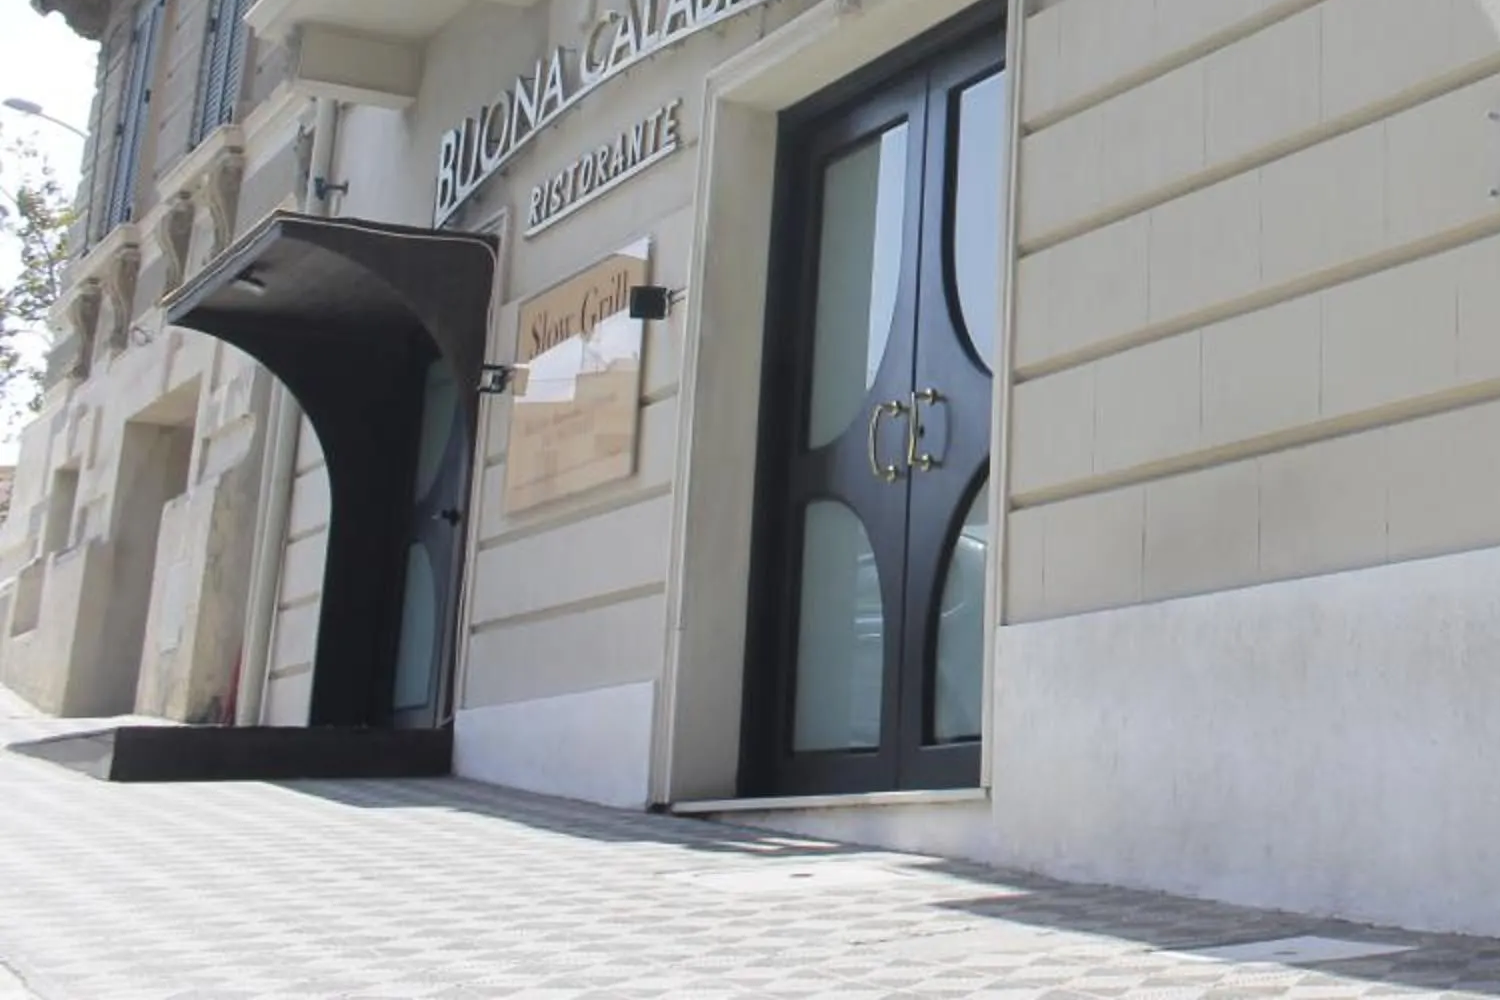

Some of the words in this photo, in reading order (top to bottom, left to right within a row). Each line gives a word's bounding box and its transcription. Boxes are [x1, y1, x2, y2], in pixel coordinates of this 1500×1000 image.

[435, 45, 567, 222] BUONA
[527, 98, 684, 226] RISTORANTE
[529, 309, 576, 360] Slow
[580, 269, 630, 342] Grill
